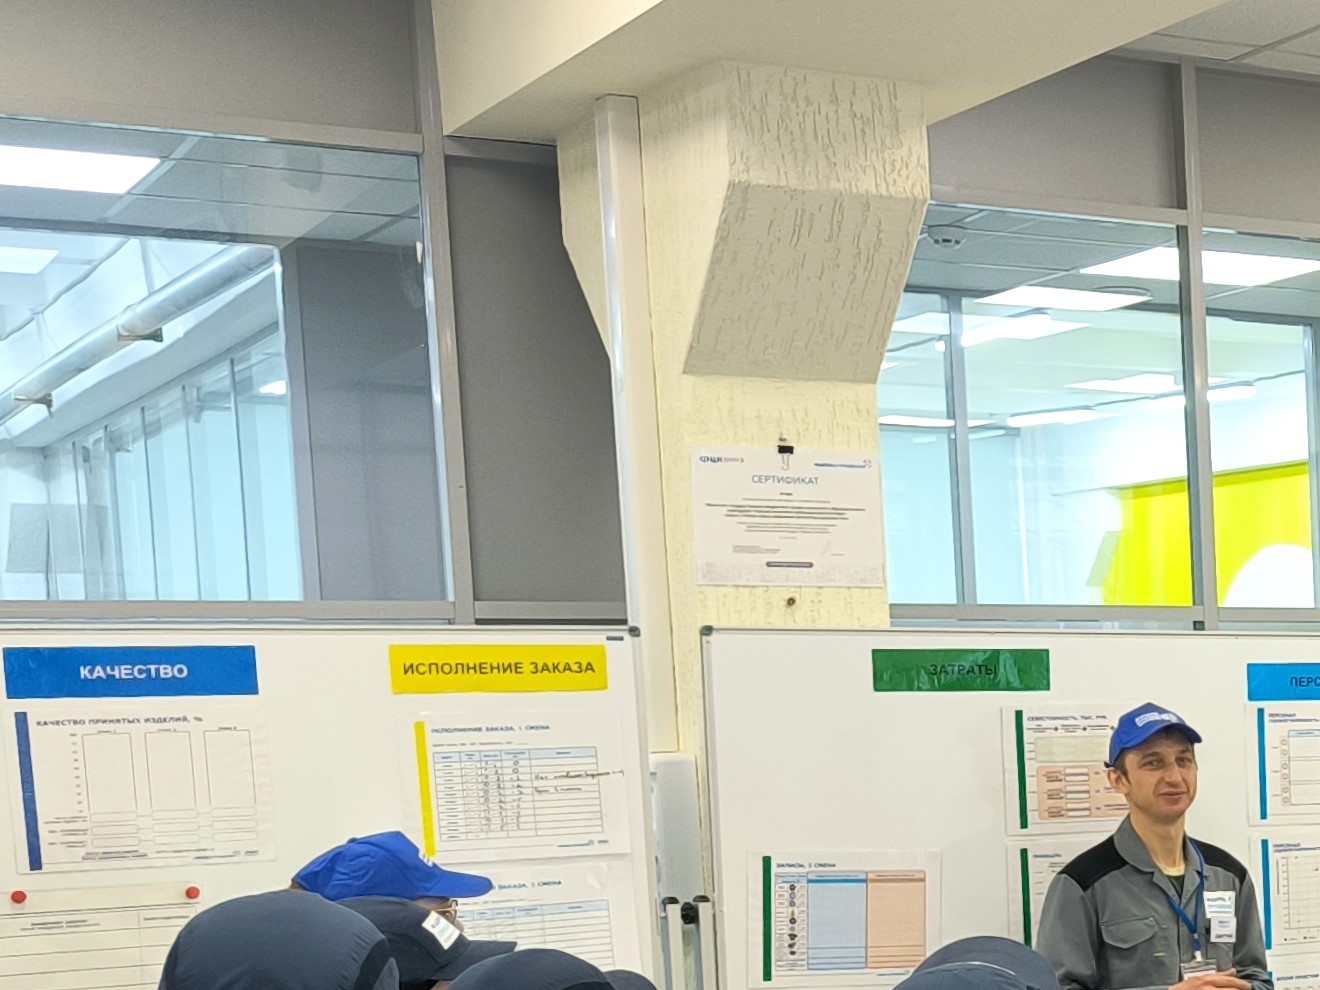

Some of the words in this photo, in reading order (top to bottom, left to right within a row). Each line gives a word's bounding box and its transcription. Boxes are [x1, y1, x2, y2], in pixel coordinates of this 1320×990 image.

[752, 474, 819, 485] СЕРТИФИКАТ
[79, 664, 188, 680] КАЧЕСТВО
[403, 662, 524, 676] ИСПОЛНЕНИЕ
[529, 661, 596, 675] ЗАКАЗА
[930, 664, 997, 676] ЗАТРАТЫ
[36, 718, 86, 727] КАЧЕСТВО
[88, 717, 141, 726] ПРИНЯТЫХ
